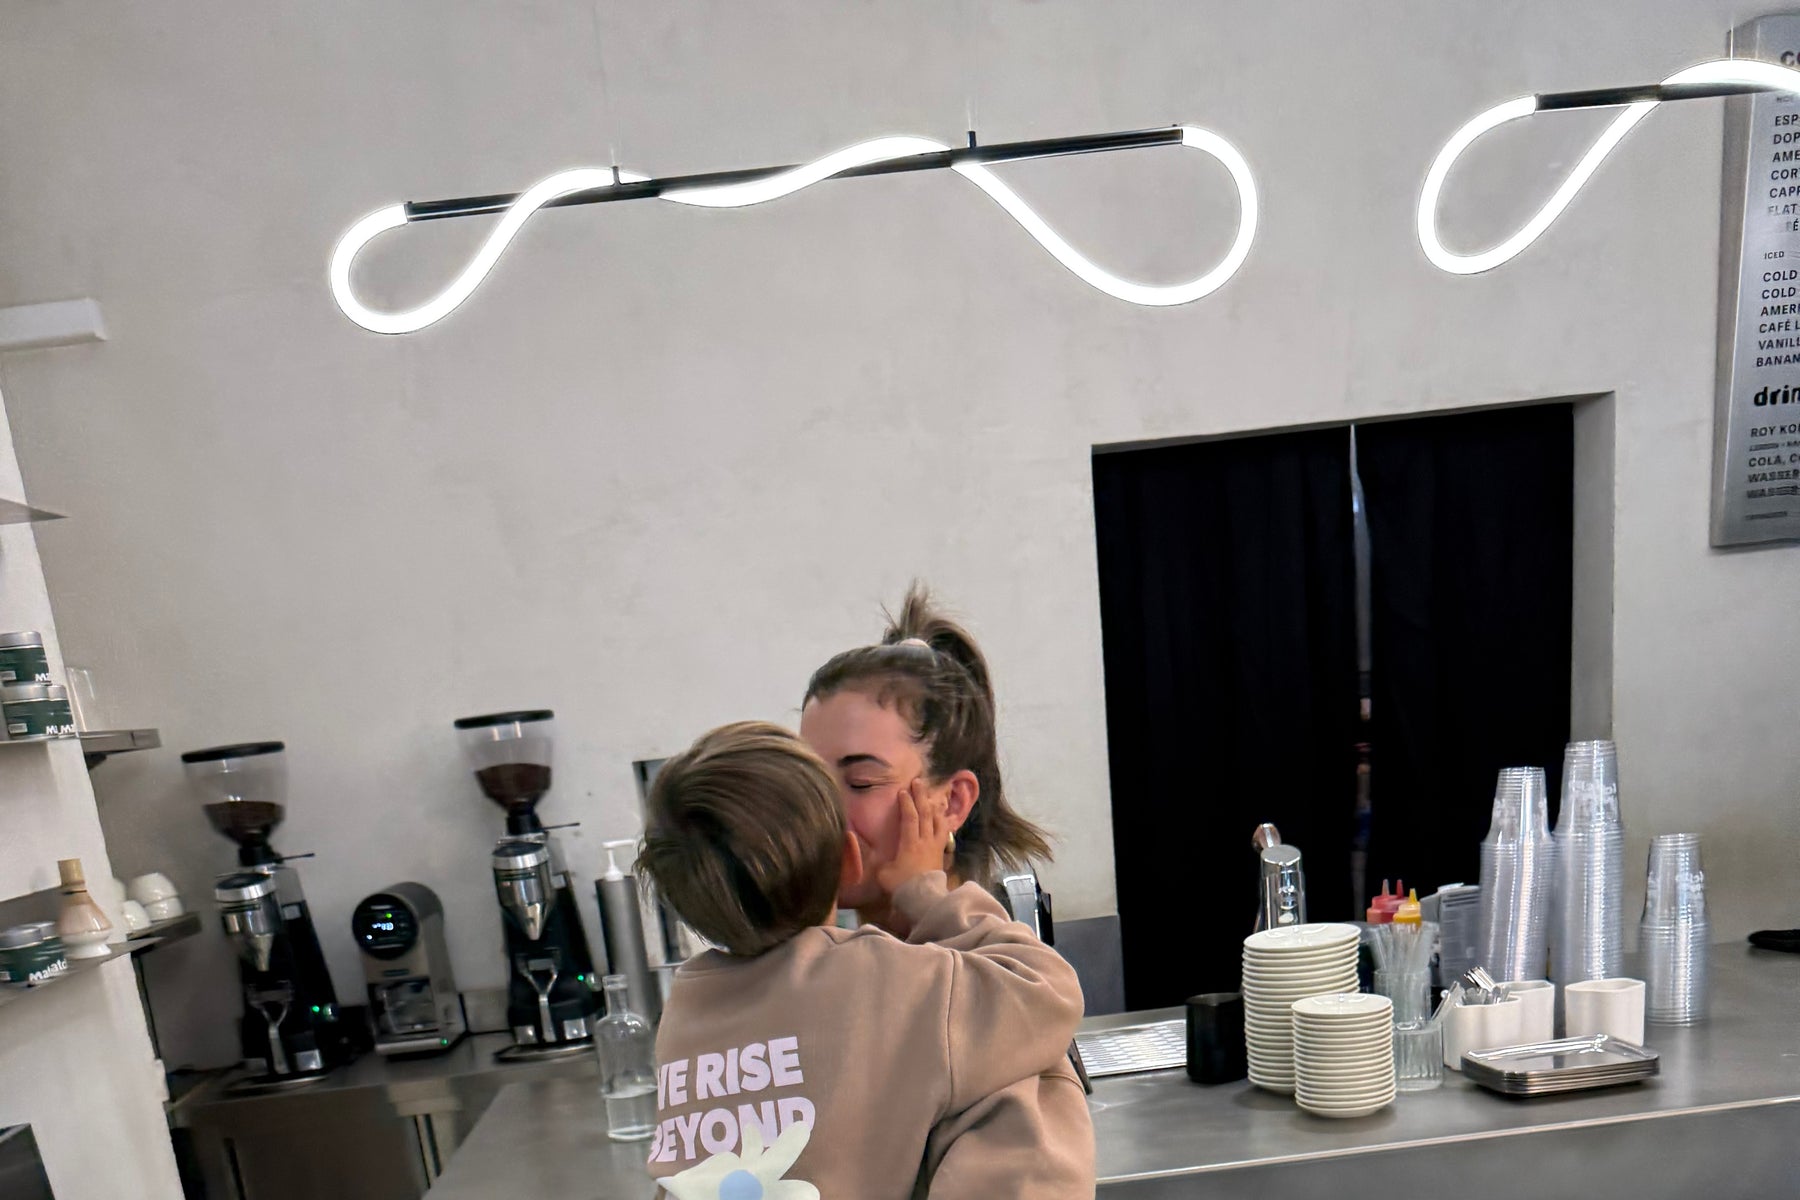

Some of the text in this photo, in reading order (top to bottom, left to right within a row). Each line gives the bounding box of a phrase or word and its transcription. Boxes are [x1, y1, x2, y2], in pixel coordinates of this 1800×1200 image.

[1764, 250, 1785, 260] ICED
[1763, 269, 1798, 283] COLD
[1761, 287, 1796, 300] COLD
[1759, 318, 1791, 334] CAFÉ
[1751, 426, 1776, 437] ROY
[696, 1036, 804, 1100] RISE
[648, 1097, 816, 1164] BEYOND
